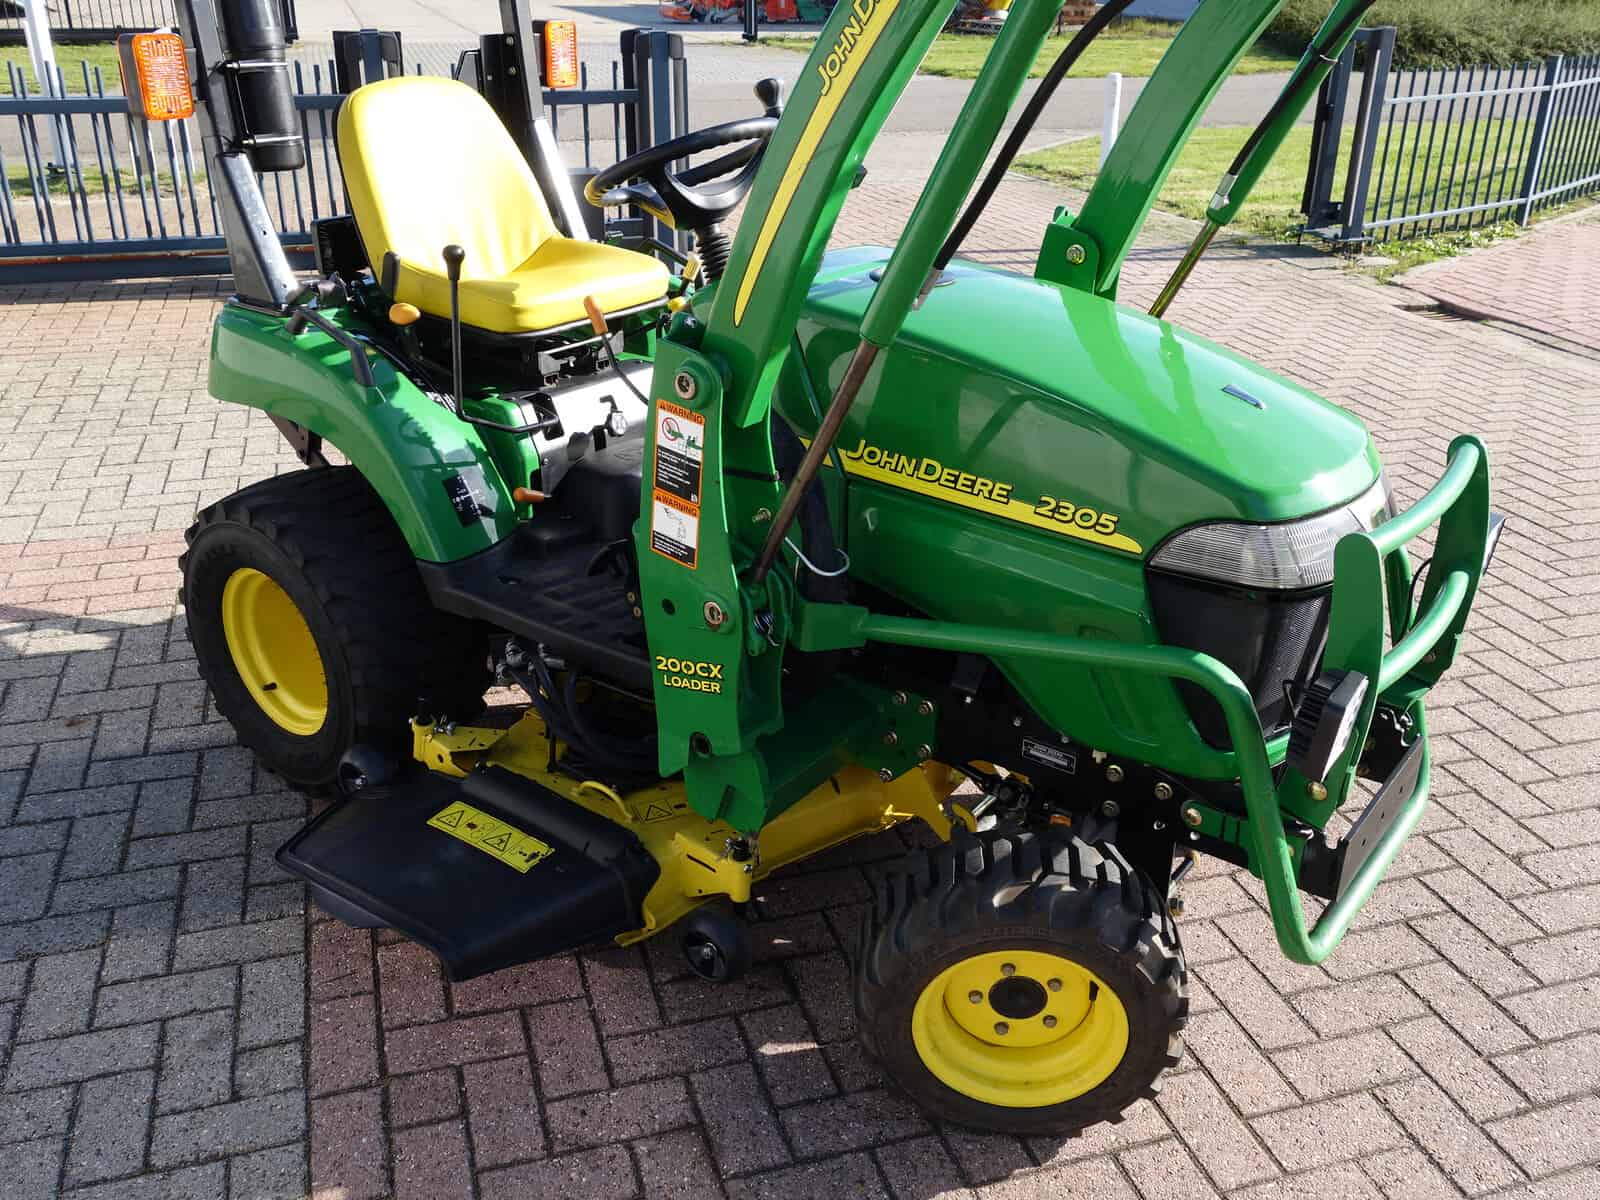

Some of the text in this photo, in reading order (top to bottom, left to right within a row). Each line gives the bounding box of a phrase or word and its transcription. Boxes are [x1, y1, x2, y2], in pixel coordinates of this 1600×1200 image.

[817, 0, 882, 97] JOHN D
[666, 405, 703, 424] WARNING
[846, 439, 1121, 535] JOHN DEERE 2305
[661, 496, 698, 517] WARNING
[655, 655, 723, 680] 200CX
[663, 674, 722, 695] LOADER
